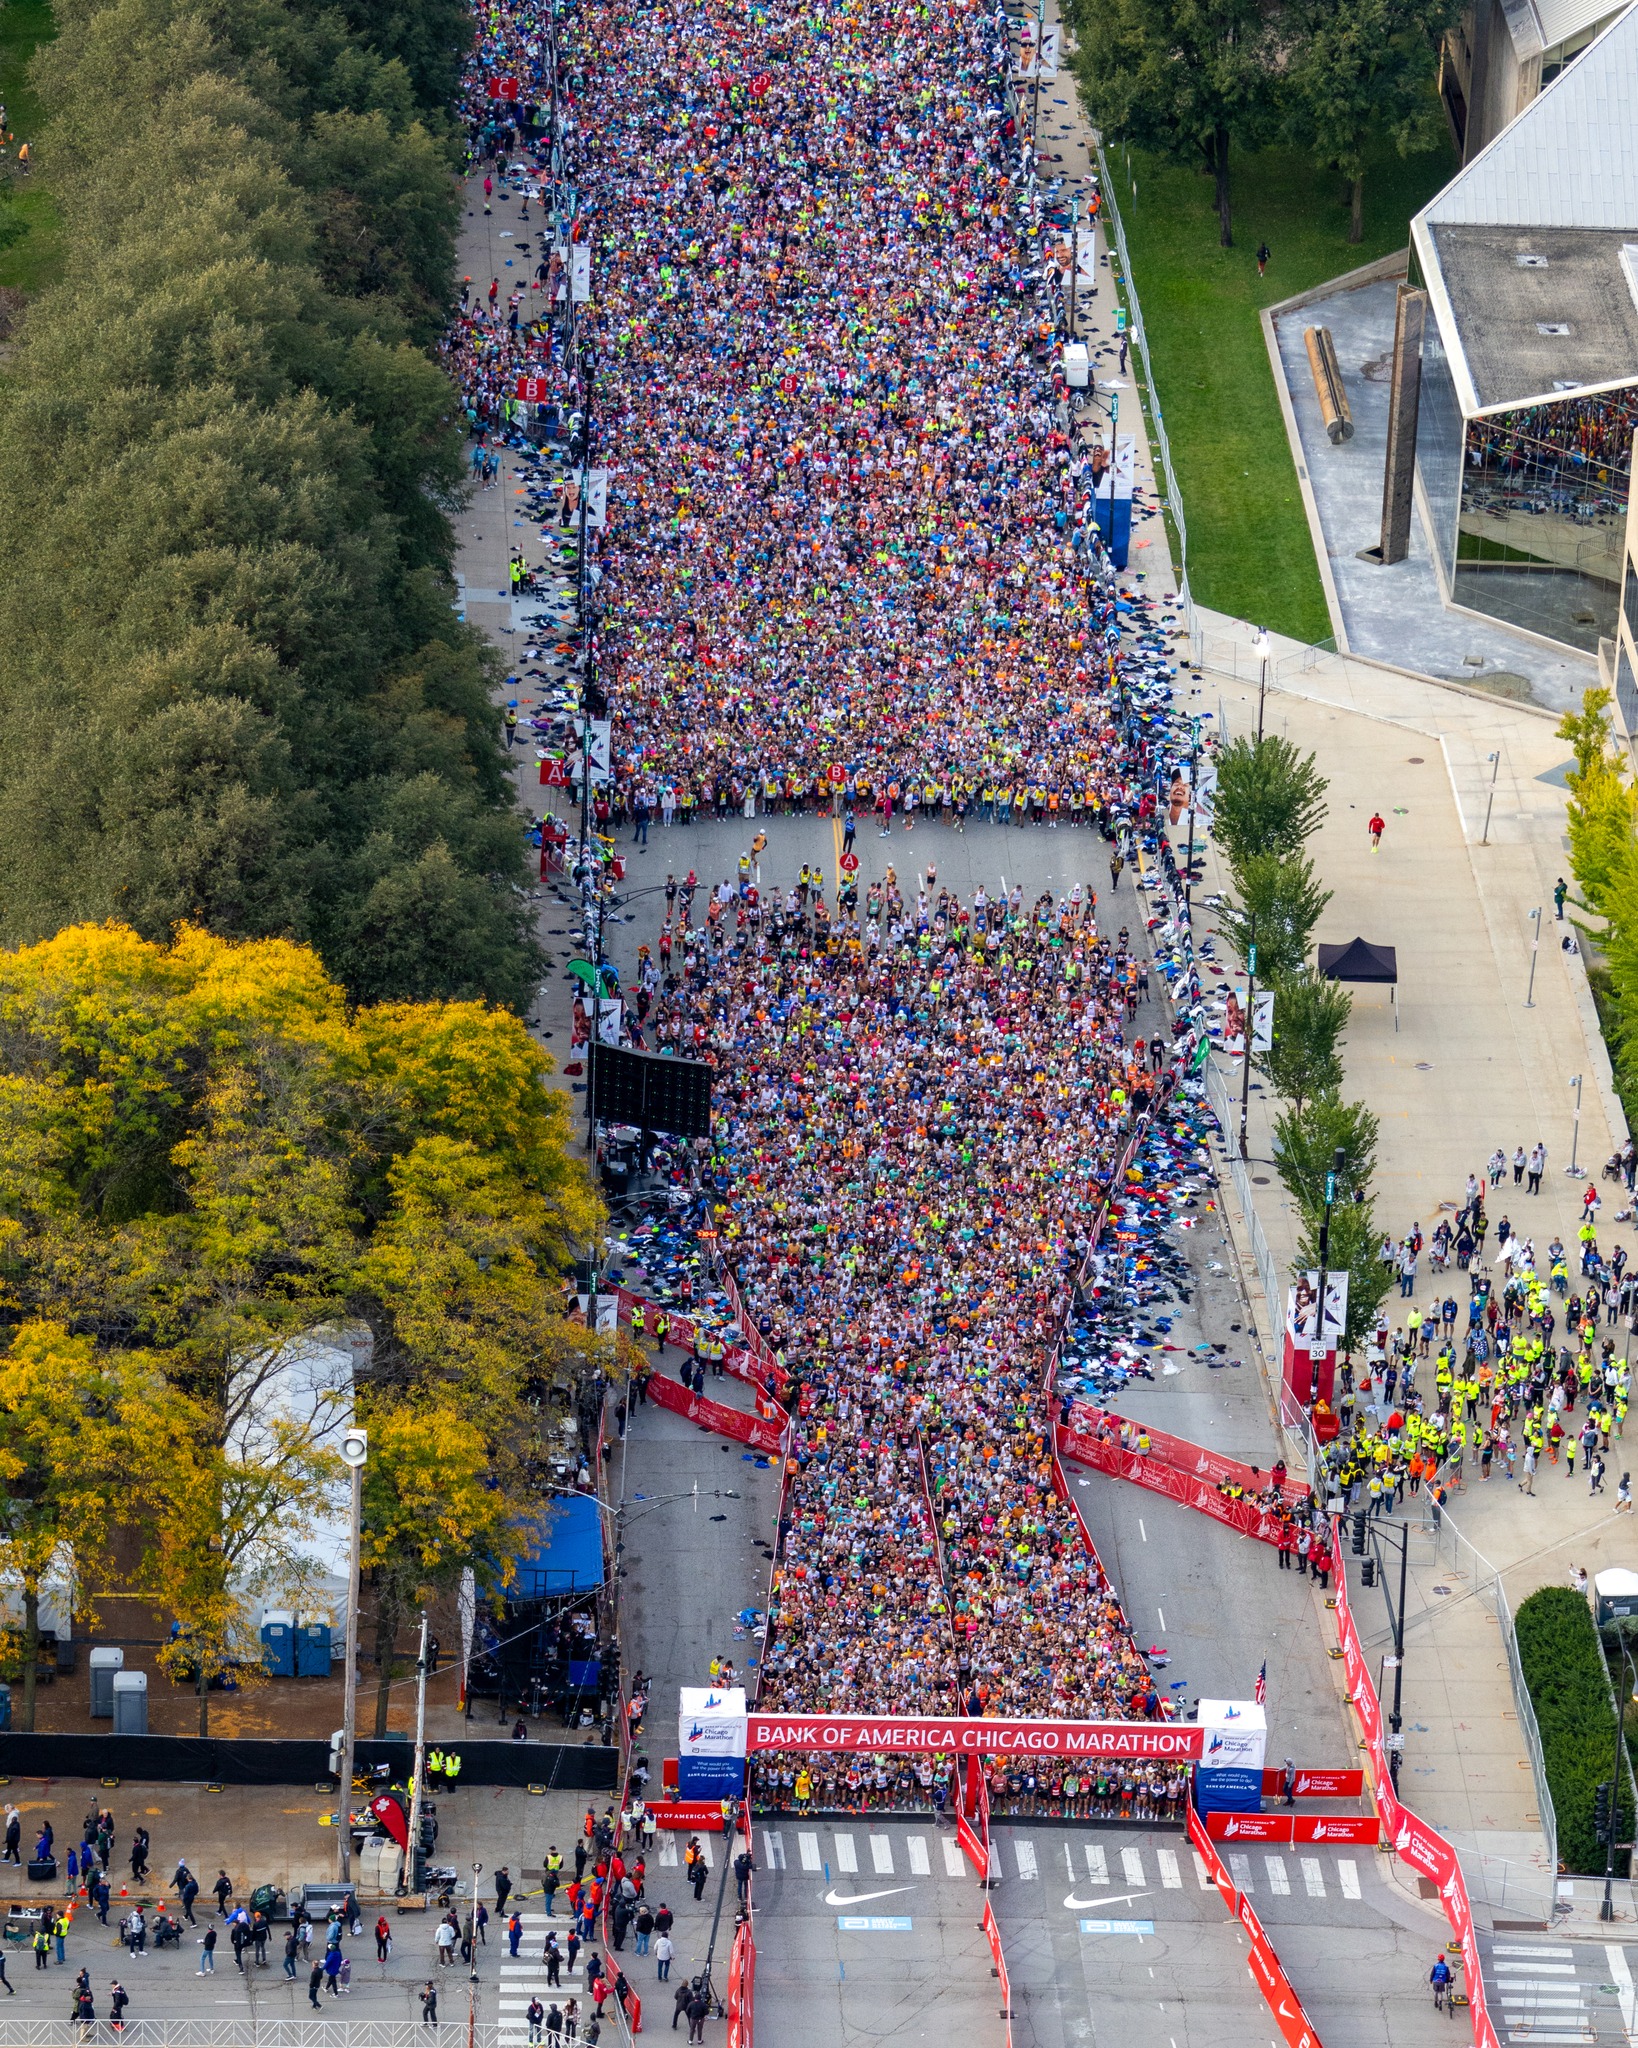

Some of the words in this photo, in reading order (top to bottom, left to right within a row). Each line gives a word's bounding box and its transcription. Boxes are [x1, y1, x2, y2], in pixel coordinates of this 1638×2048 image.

[499, 81, 509, 95] C
[753, 82, 761, 92] C
[526, 382, 538, 396] B
[785, 379, 792, 388] B
[548, 766, 562, 782] A
[832, 766, 841, 776] B
[844, 855, 854, 867] A
[757, 1726, 817, 1743] BANK
[823, 1728, 852, 1744] OF
[856, 1729, 956, 1746] AMERICA
[962, 1730, 1058, 1749] CHICAGO
[1066, 1732, 1191, 1752] MARATHON
[1412, 1838, 1434, 1860] Chicago
[1413, 1831, 1423, 1840] BANK
[1427, 1842, 1442, 1856] AMERICA
[1411, 1847, 1439, 1874] Marathon
